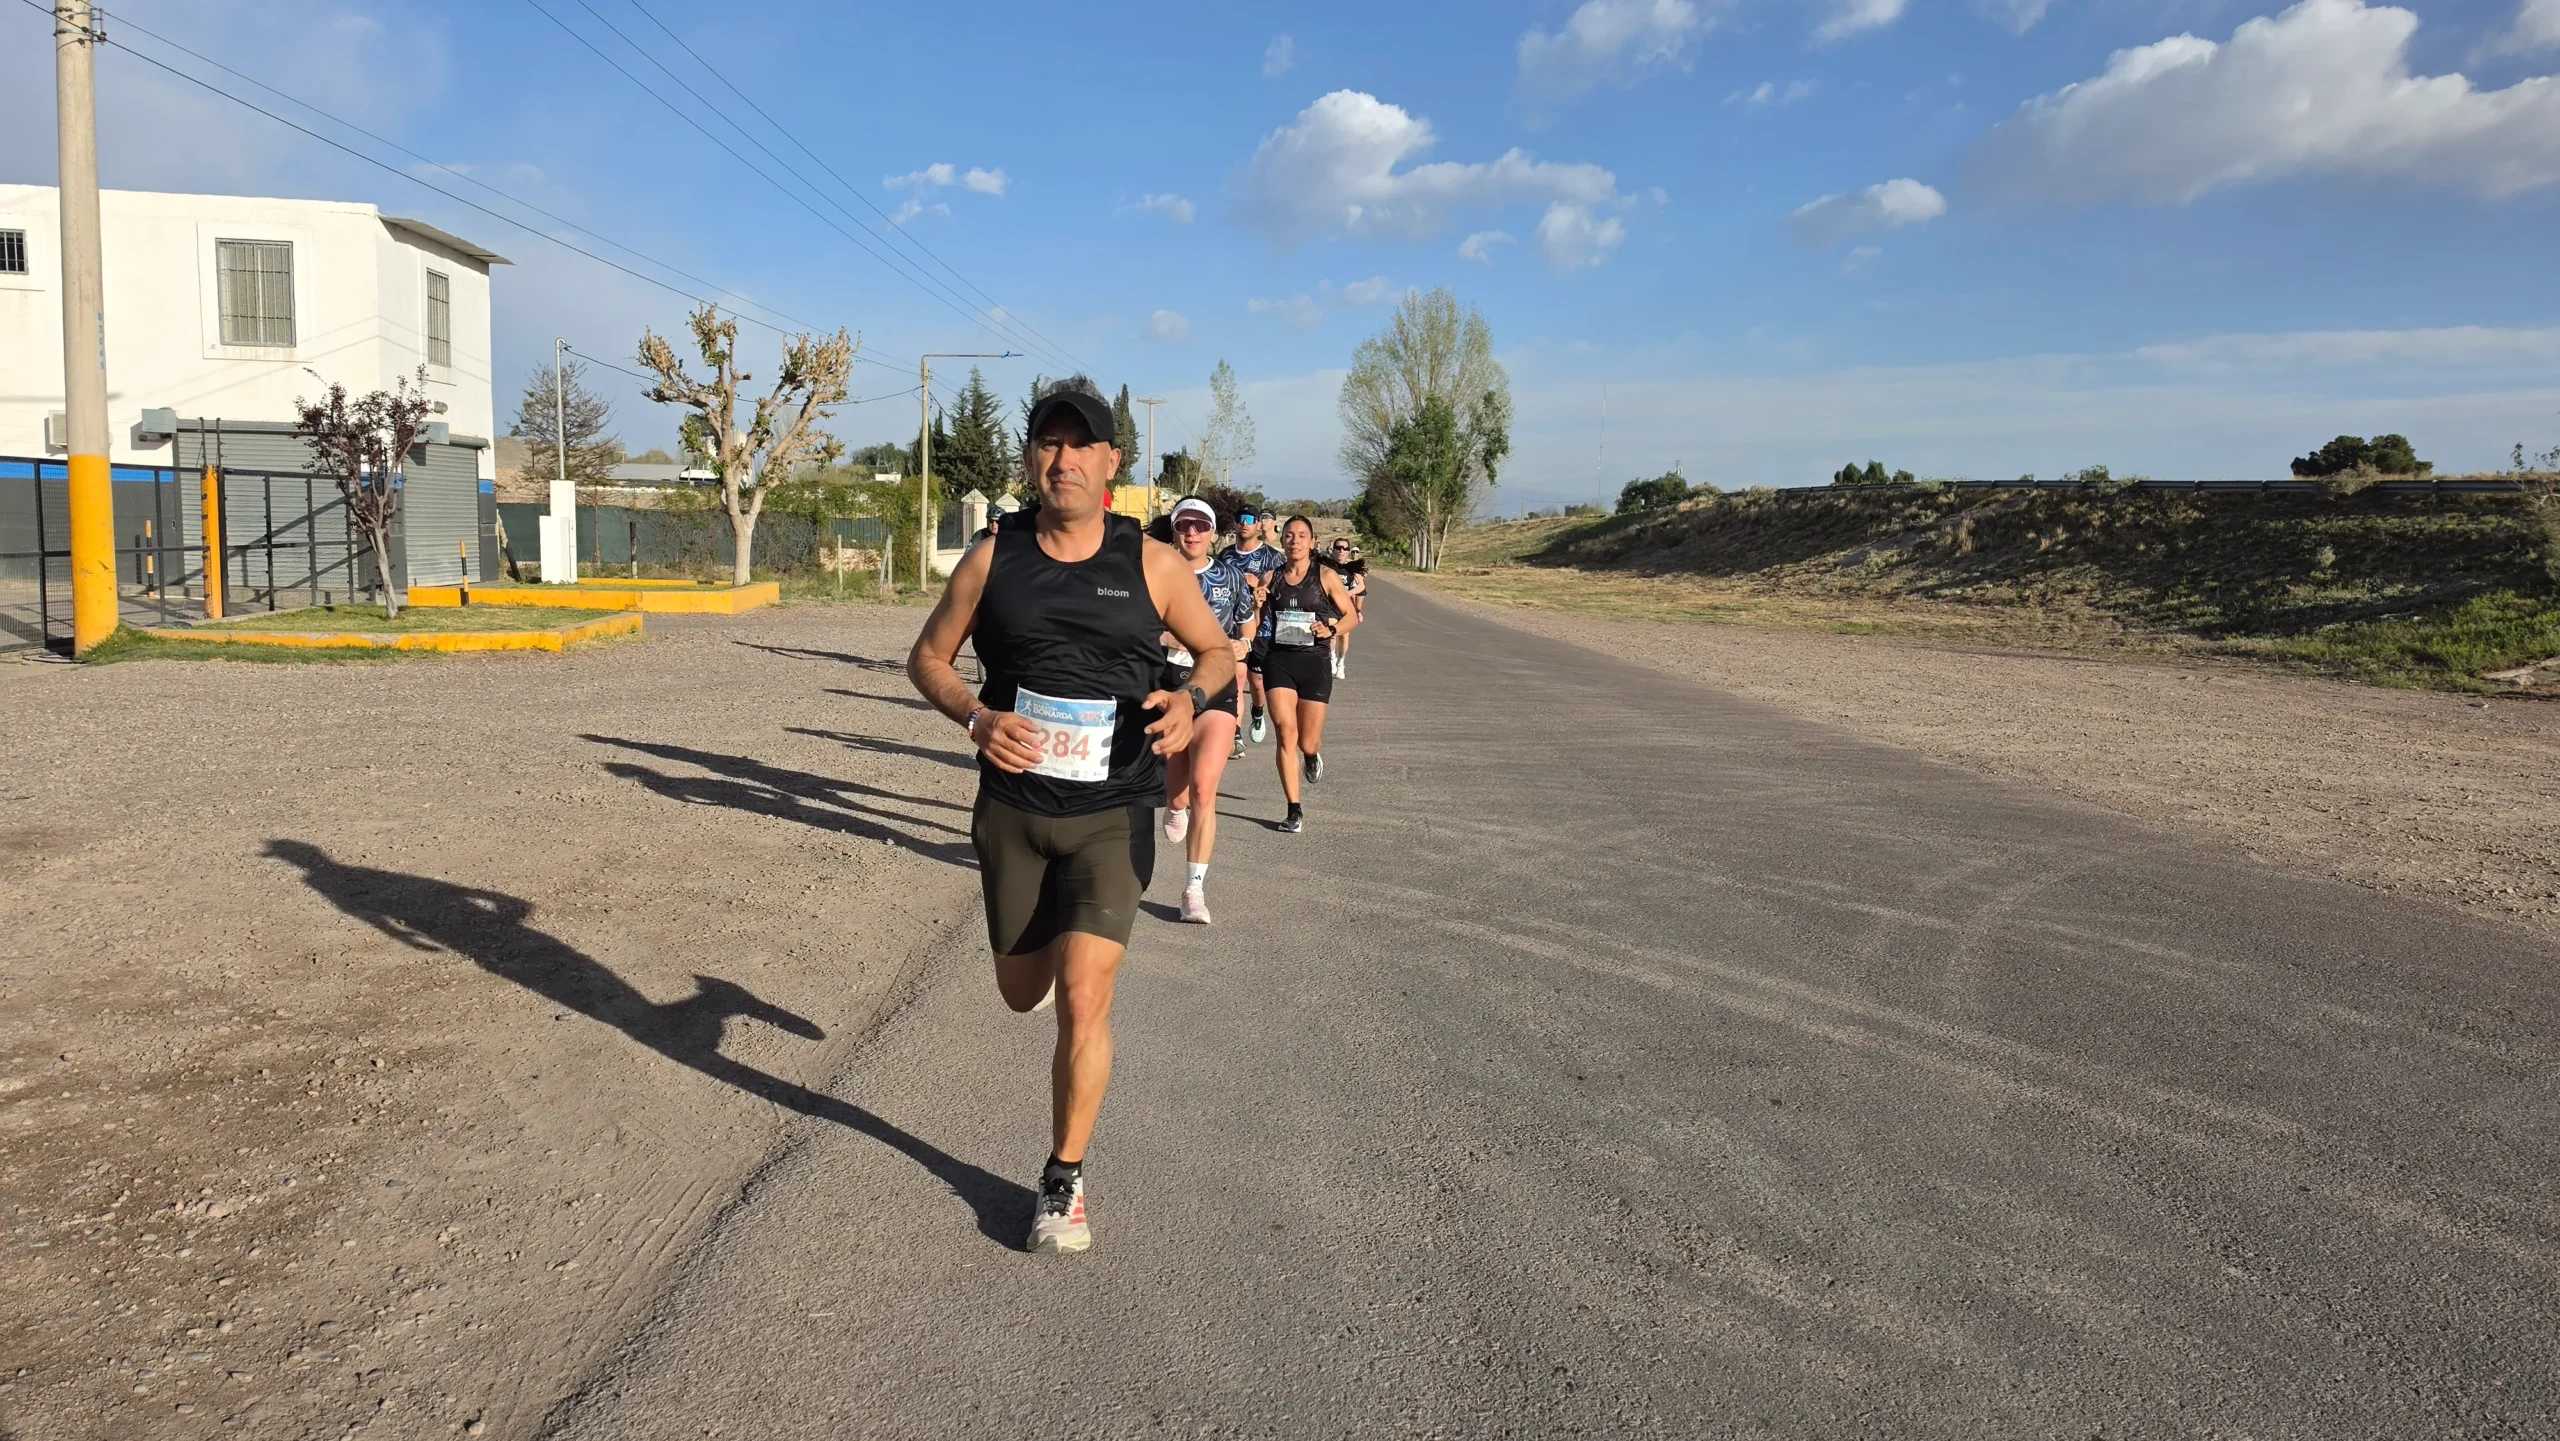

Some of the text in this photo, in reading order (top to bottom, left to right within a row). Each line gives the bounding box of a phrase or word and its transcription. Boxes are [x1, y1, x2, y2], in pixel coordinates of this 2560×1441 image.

[1097, 587, 1130, 598] bloom
[1033, 706, 1074, 720] BONARDA
[1036, 727, 1090, 761] 284
